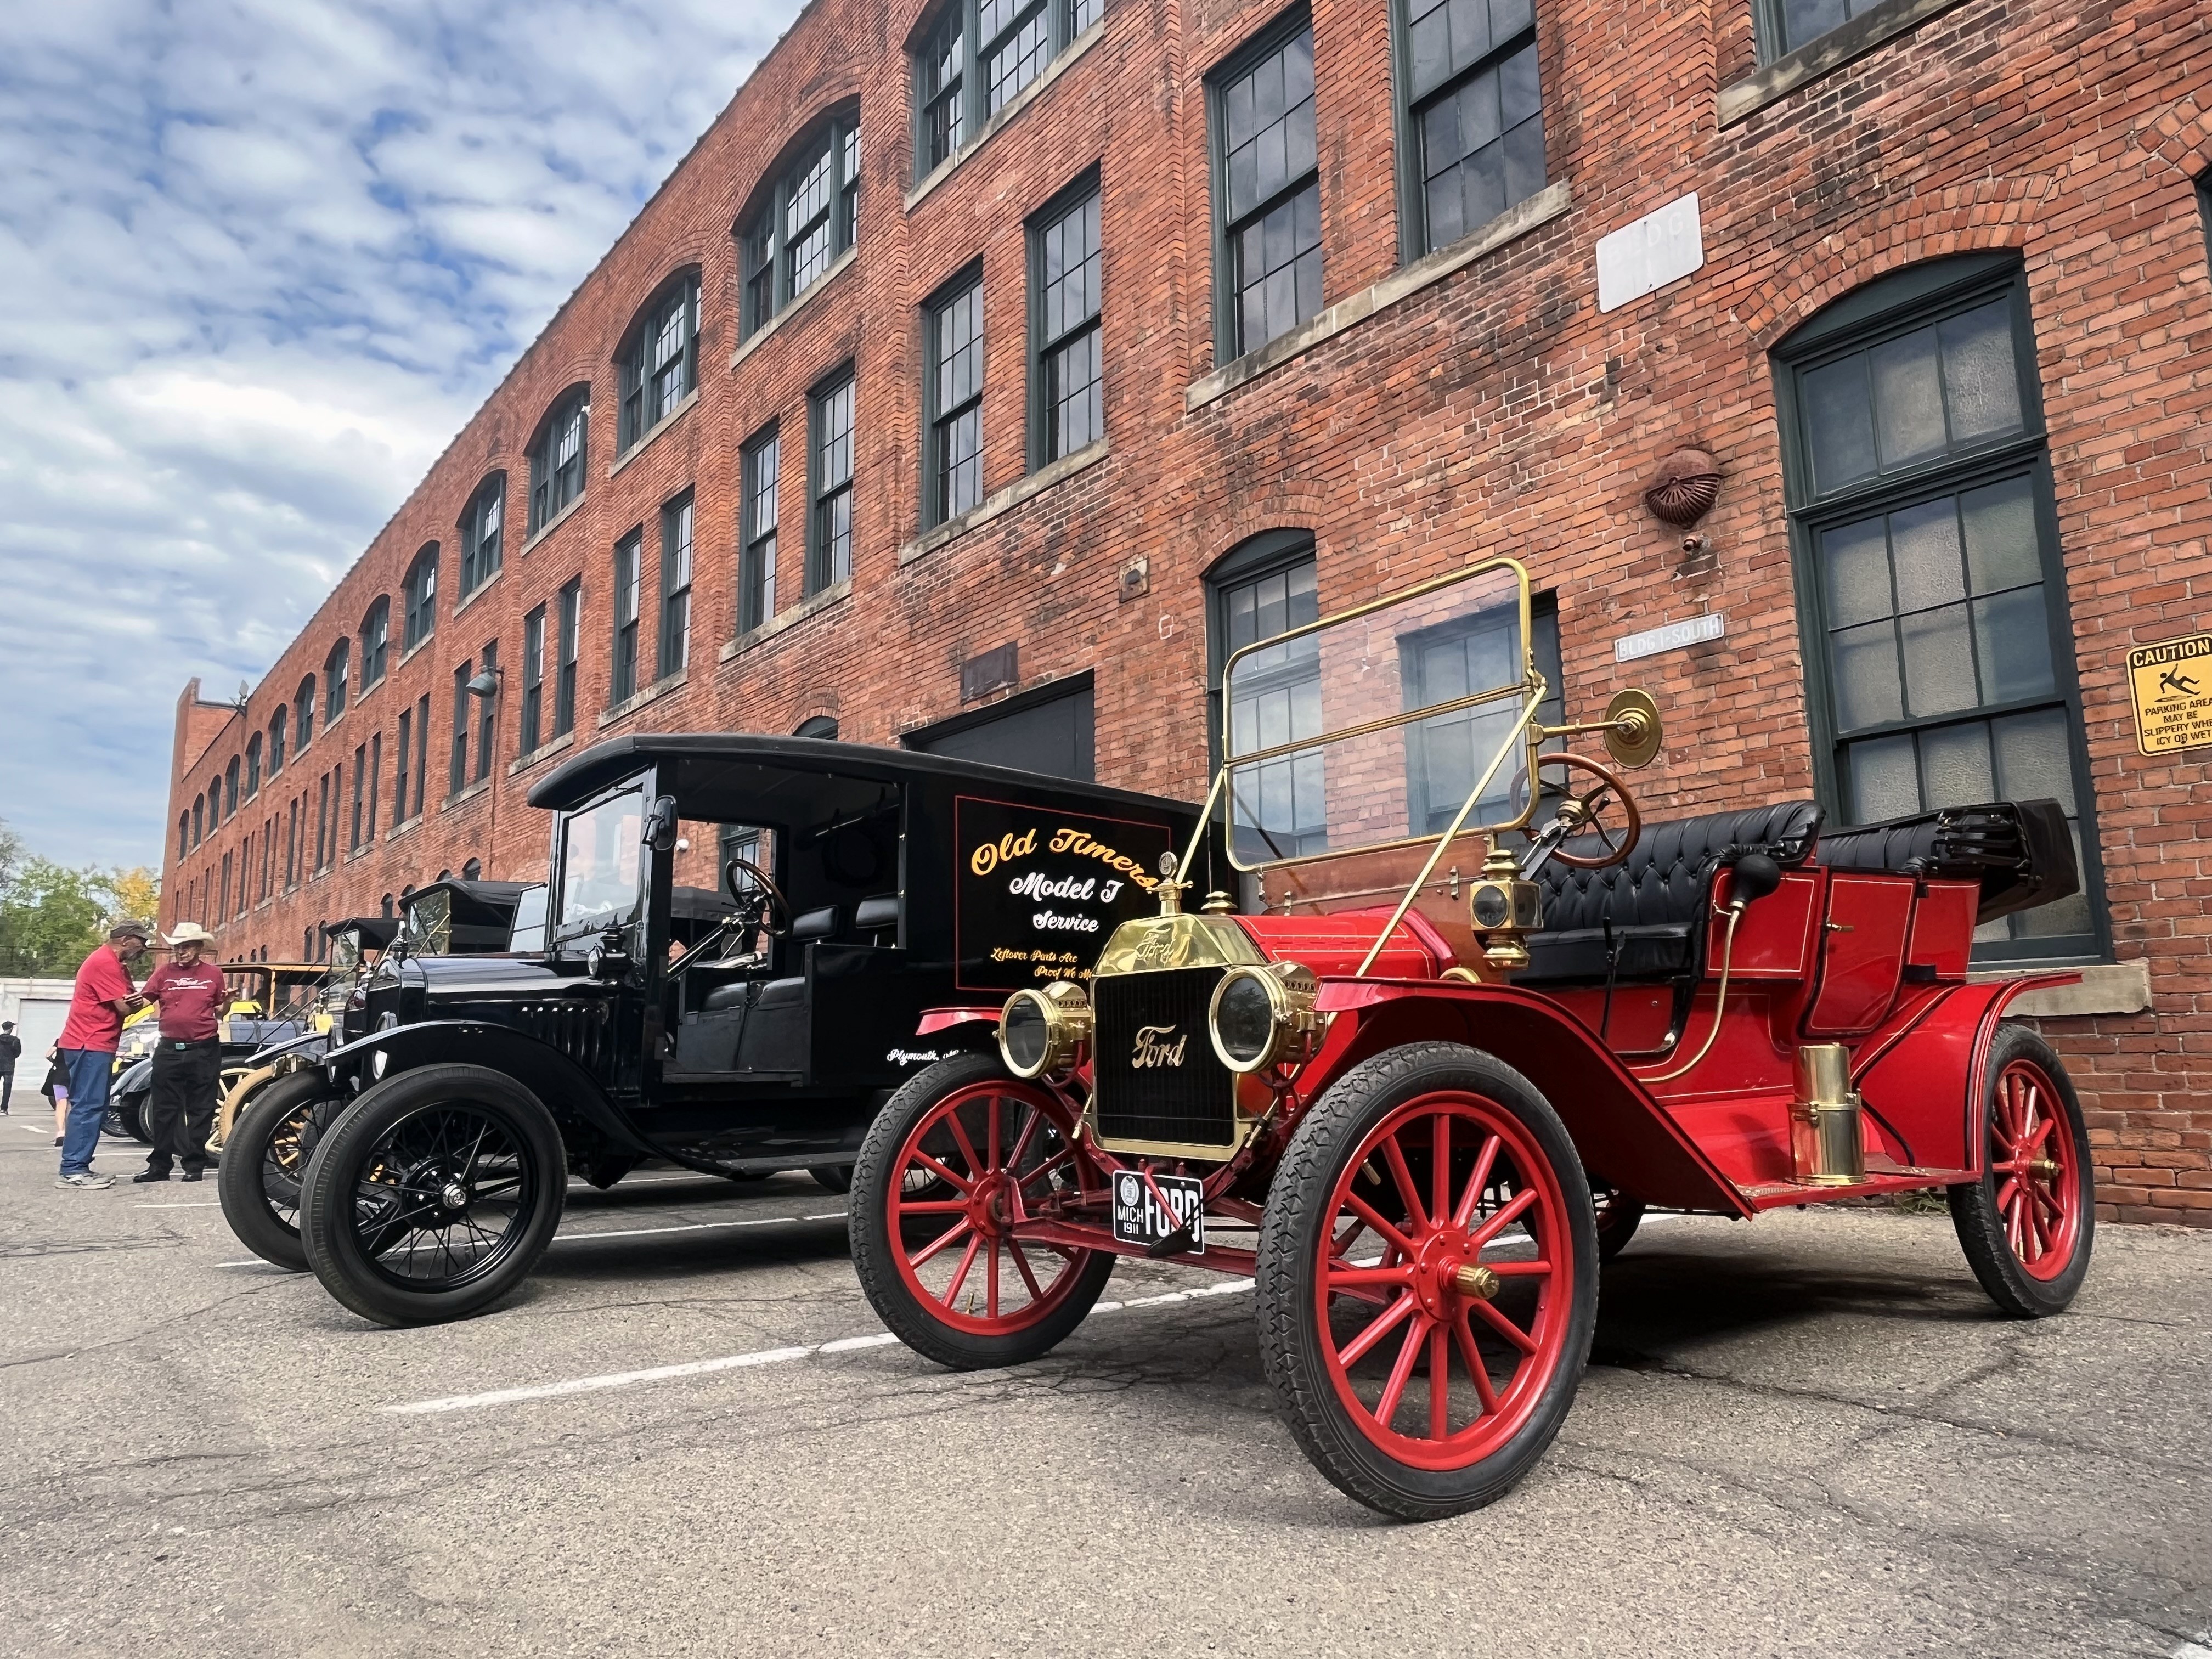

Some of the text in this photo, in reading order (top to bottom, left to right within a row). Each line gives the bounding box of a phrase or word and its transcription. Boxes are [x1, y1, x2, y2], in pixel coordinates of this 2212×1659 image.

[1619, 635, 1655, 657] BLDG
[2133, 639, 2210, 667] CAUTION
[2145, 697, 2212, 716] PARKING AREA
[2163, 710, 2198, 723] MAY BE
[2144, 719, 2212, 737] SLIPPERY WHE
[2157, 736, 2171, 745] ICY
[2190, 730, 2211, 740] WET
[971, 828, 1159, 888] Old Timers
[1009, 872, 1096, 901] Model
[1032, 910, 1099, 932] Service
[990, 947, 1078, 963] Leftover Parts Are
[1034, 966, 1062, 980] Proof
[1063, 966, 1076, 978] We
[1132, 1024, 1188, 1069] Ford
[887, 1048, 939, 1066] Plymouth,
[1118, 1205, 1144, 1223] MICH
[1144, 1184, 1200, 1243] FORD
[1124, 1222, 1139, 1234] 1911
